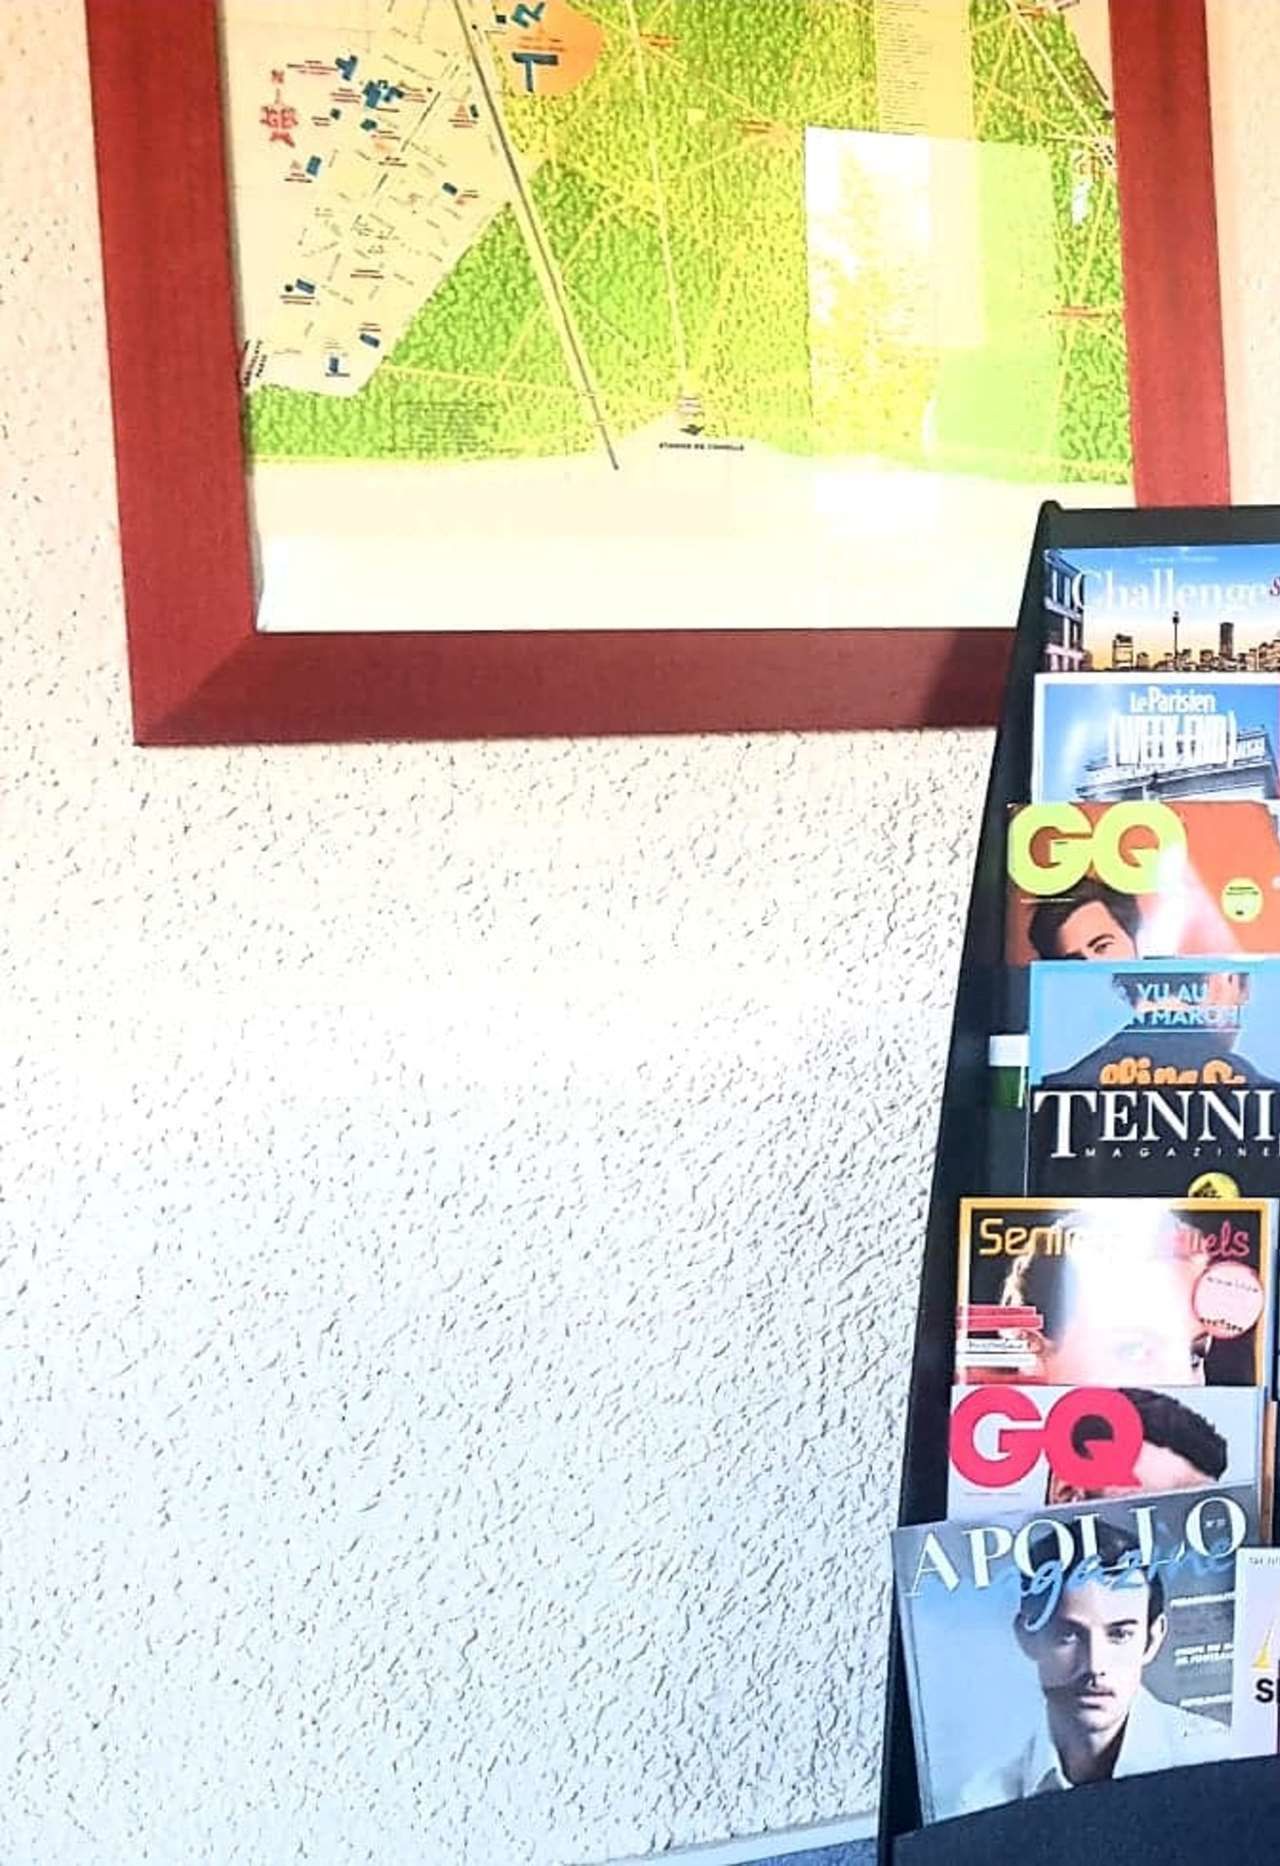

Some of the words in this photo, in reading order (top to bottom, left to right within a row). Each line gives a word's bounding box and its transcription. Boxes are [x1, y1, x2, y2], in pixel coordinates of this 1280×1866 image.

[1130, 692, 1149, 713] Le
[1148, 686, 1217, 714] Parisien
[1007, 800, 1188, 896] GQ
[1084, 1147, 1271, 1158] MAGAZINE
[949, 1386, 1144, 1488] GQ
[902, 1496, 1247, 1598] APOLLO
